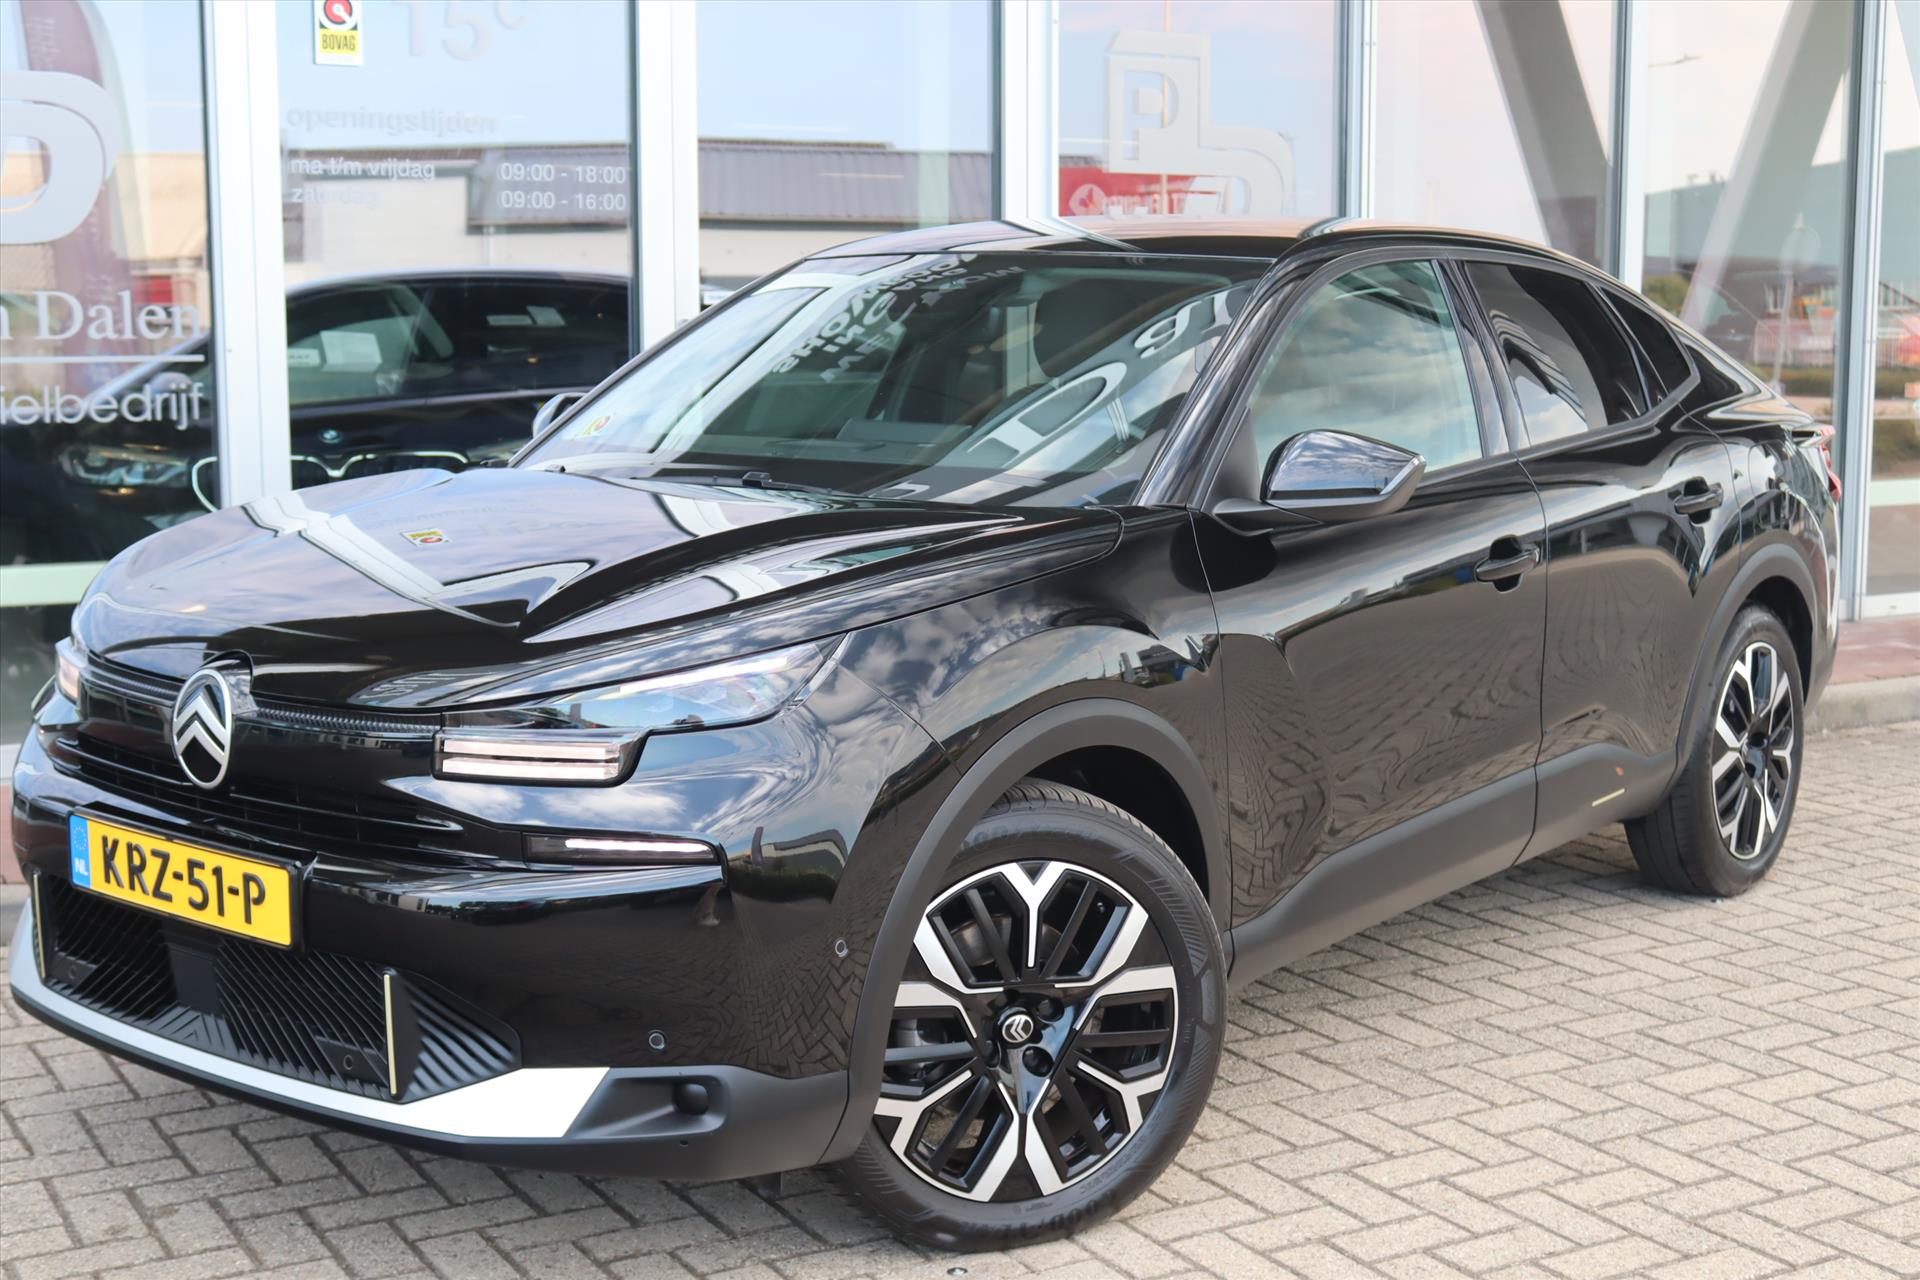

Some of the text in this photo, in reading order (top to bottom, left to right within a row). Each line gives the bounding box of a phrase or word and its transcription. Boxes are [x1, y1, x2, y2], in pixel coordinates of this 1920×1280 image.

[321, 33, 356, 52] BOVAG
[286, 105, 497, 137] openingstijden
[290, 157, 435, 182] ma t/m vrijdag
[500, 163, 554, 181] 09:00
[575, 165, 626, 184] 18:00
[501, 190, 555, 208] 09:00
[575, 192, 626, 210] 16:00
[33, 290, 203, 341] Dalen
[74, 857, 89, 876] NL
[101, 834, 266, 925] KRZ-51-P
